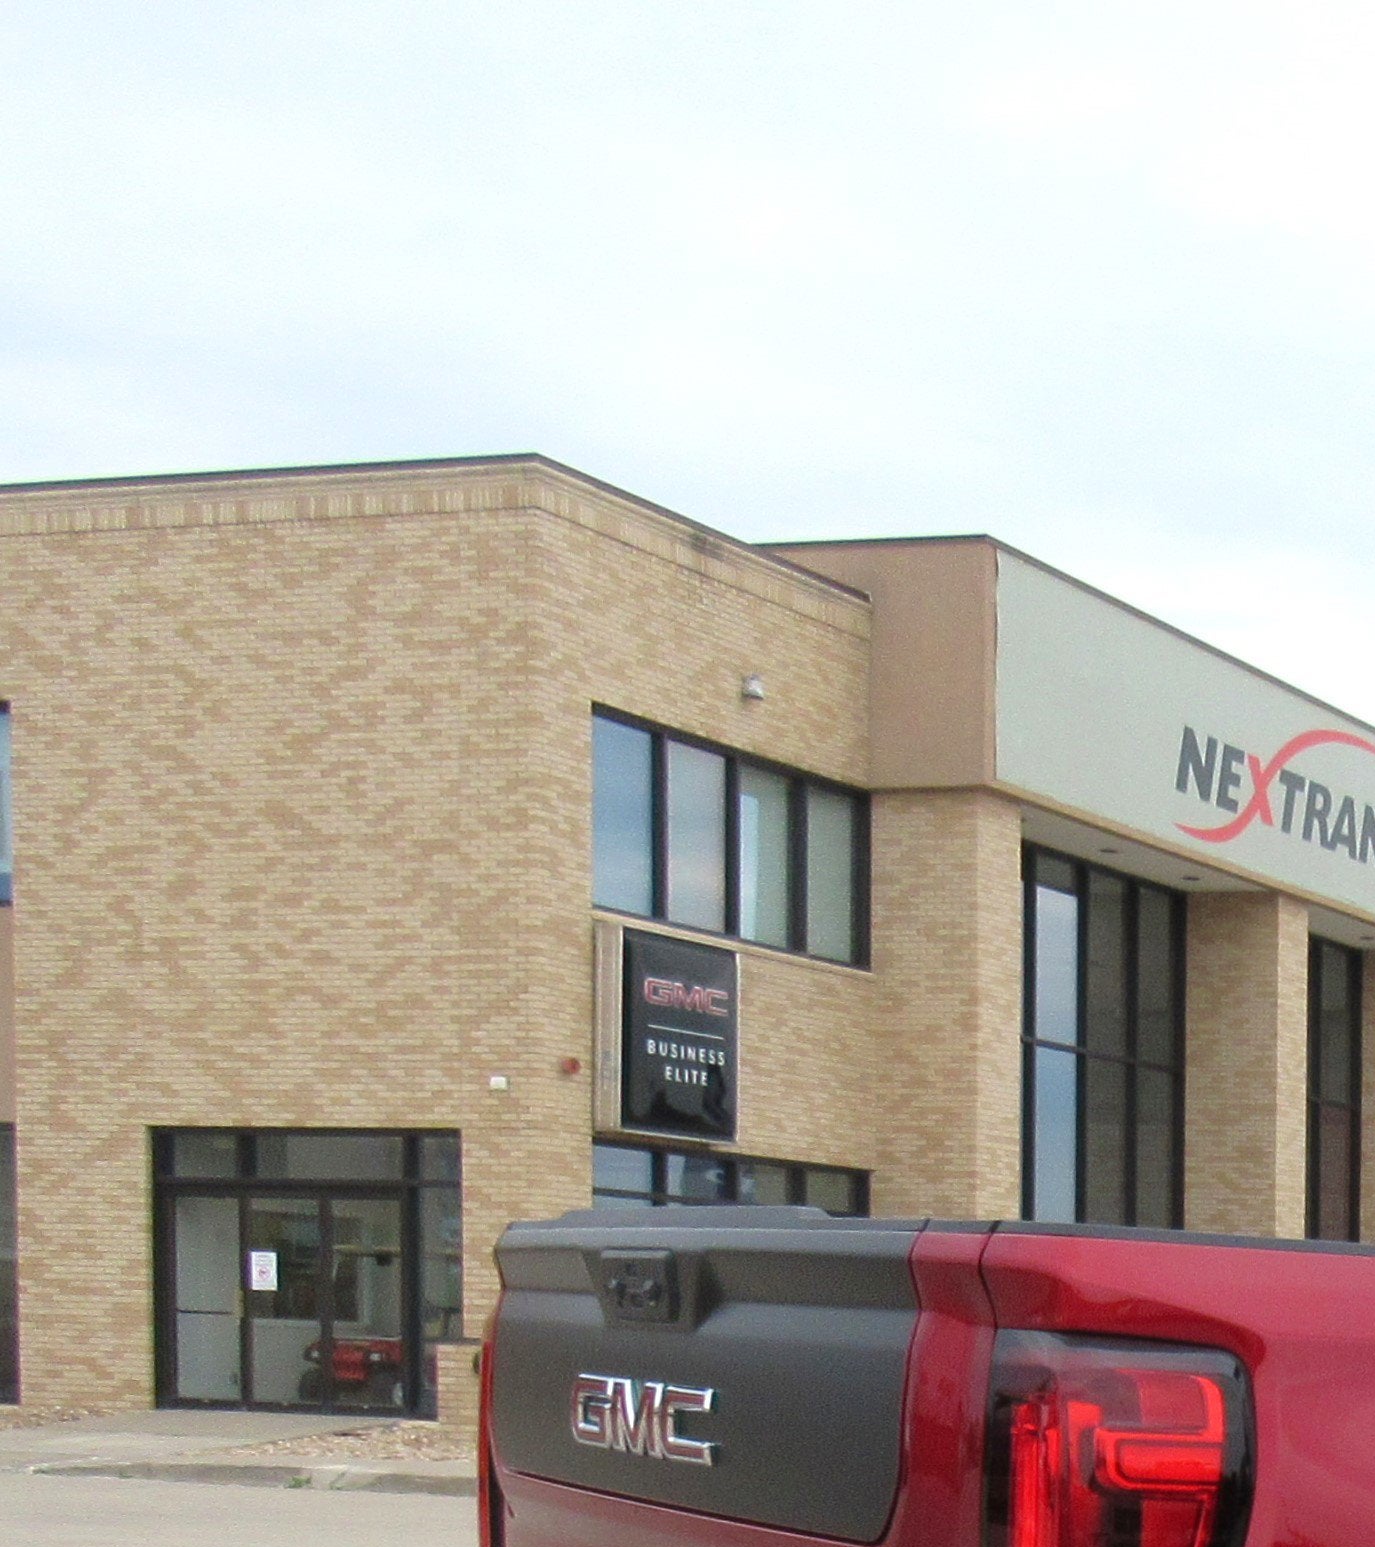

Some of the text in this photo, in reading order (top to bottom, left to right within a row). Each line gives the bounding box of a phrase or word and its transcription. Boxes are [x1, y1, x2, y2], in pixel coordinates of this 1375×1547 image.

[643, 976, 729, 1018] GMC
[646, 1038, 726, 1066] BUSINESS
[664, 1065, 709, 1087] ELITE
[570, 1372, 716, 1467] GMC
